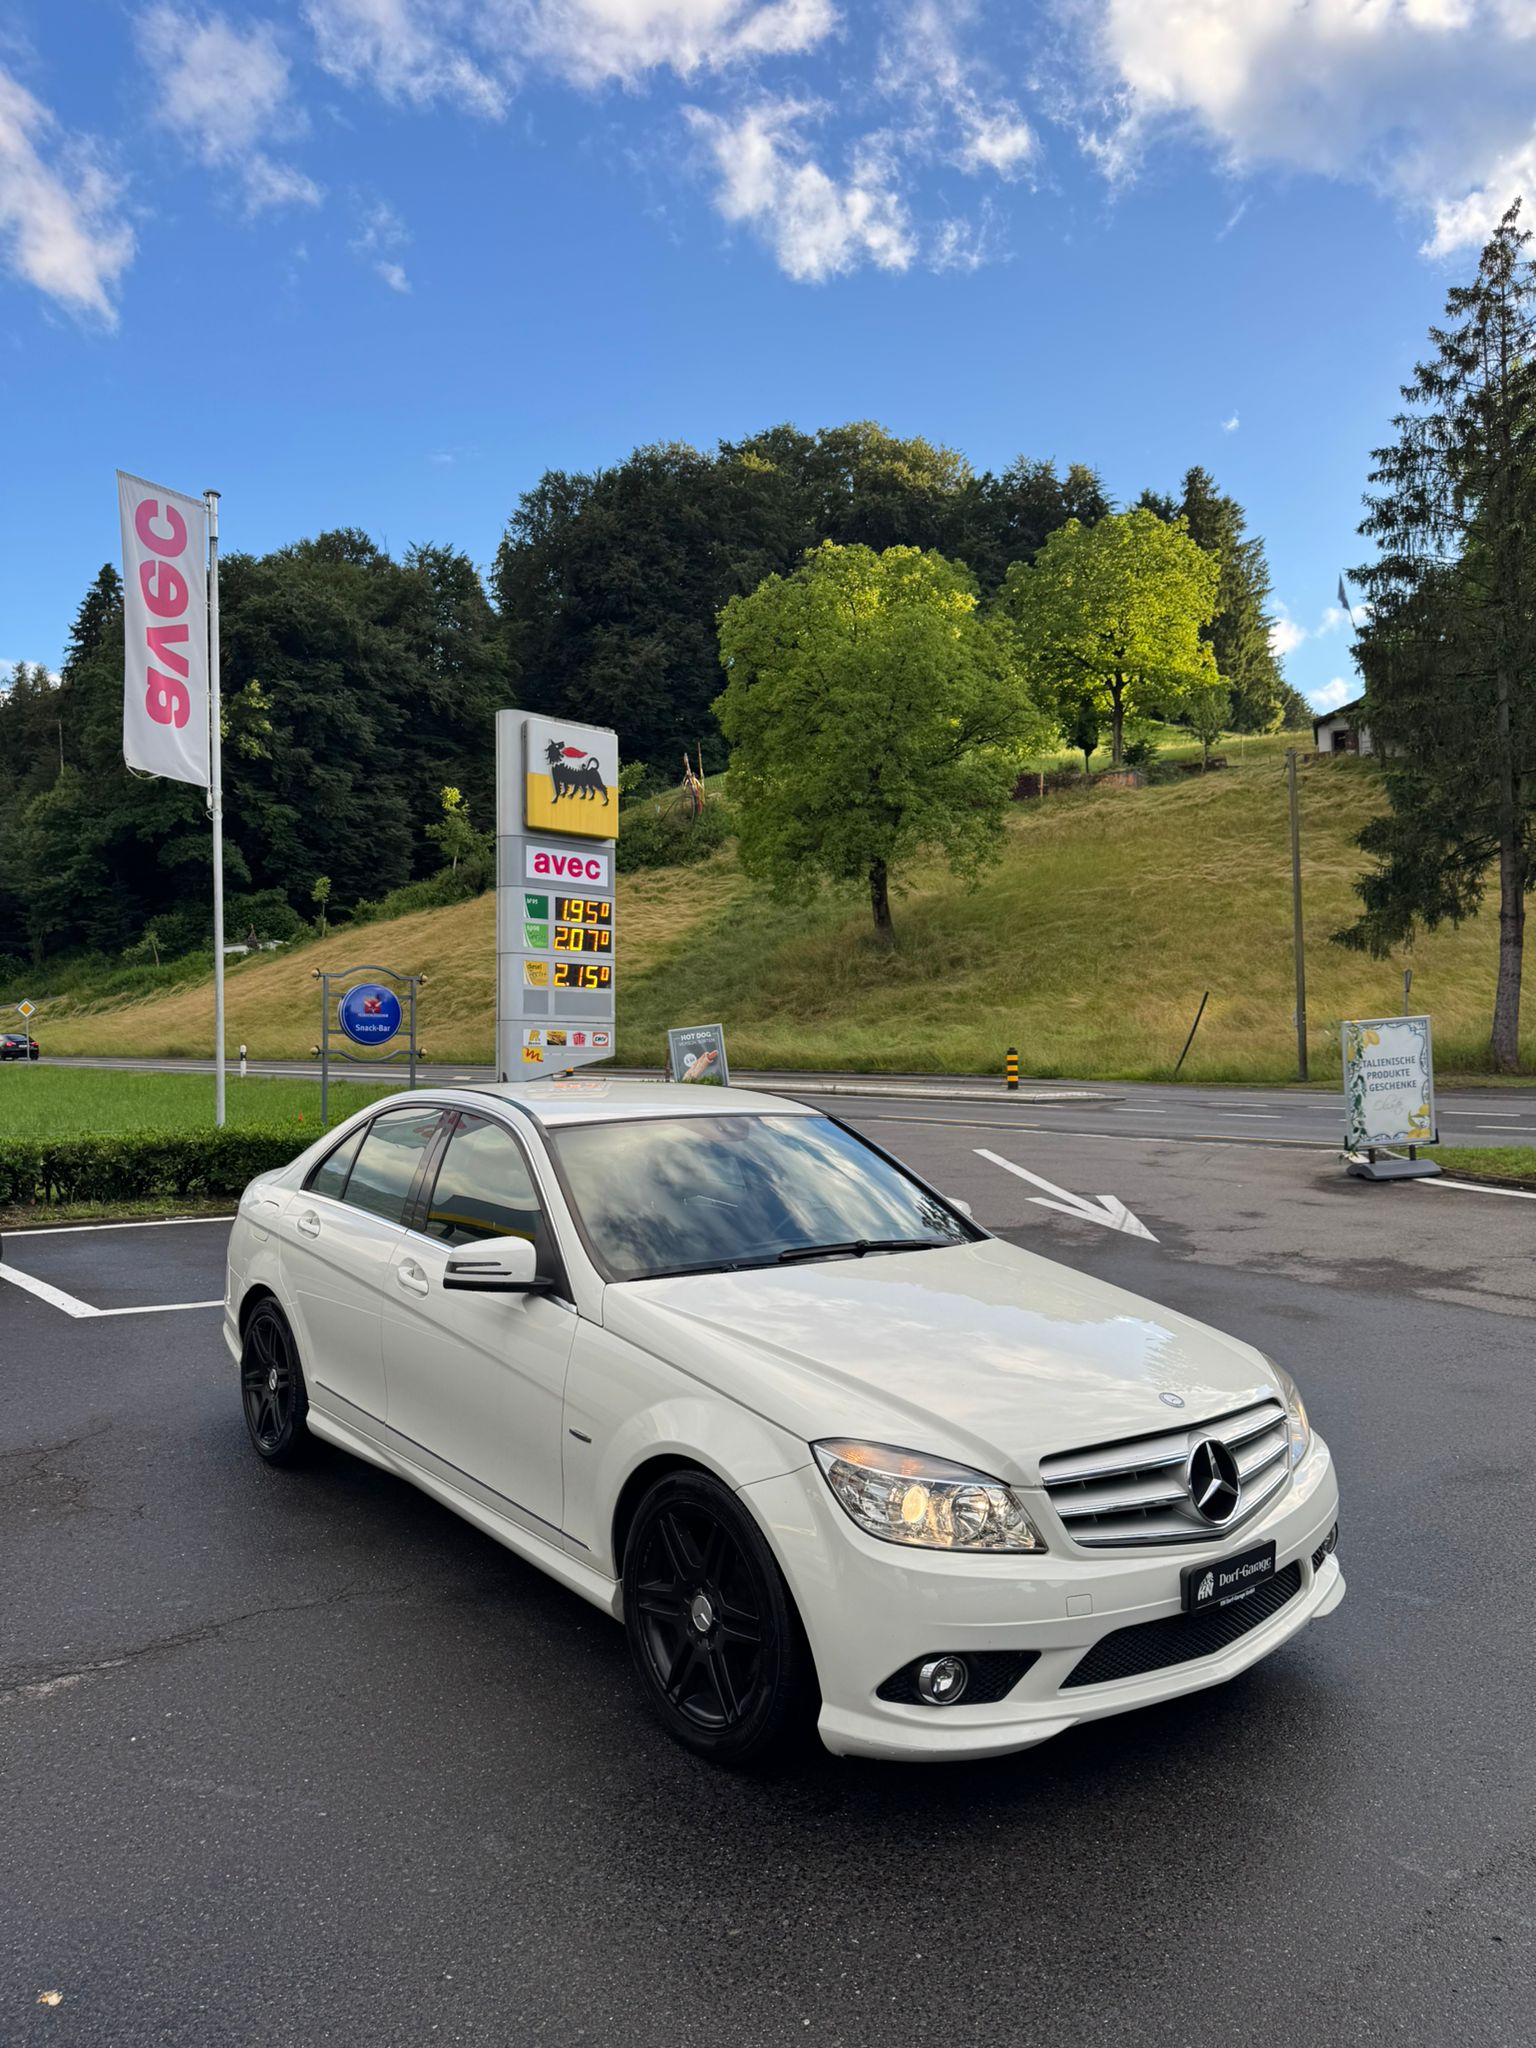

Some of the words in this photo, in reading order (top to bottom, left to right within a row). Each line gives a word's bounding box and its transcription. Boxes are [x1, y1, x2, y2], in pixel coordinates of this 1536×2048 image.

[534, 852, 601, 880] avec
[355, 1024, 391, 1032] Snack-Bar
[681, 1033, 695, 1041] HOT
[696, 1031, 711, 1039] DOG
[1366, 1068, 1411, 1080] PRODUKTE
[1369, 1080, 1417, 1092] GESCHENKE
[1219, 1557, 1272, 1587] Dorf-Garage
